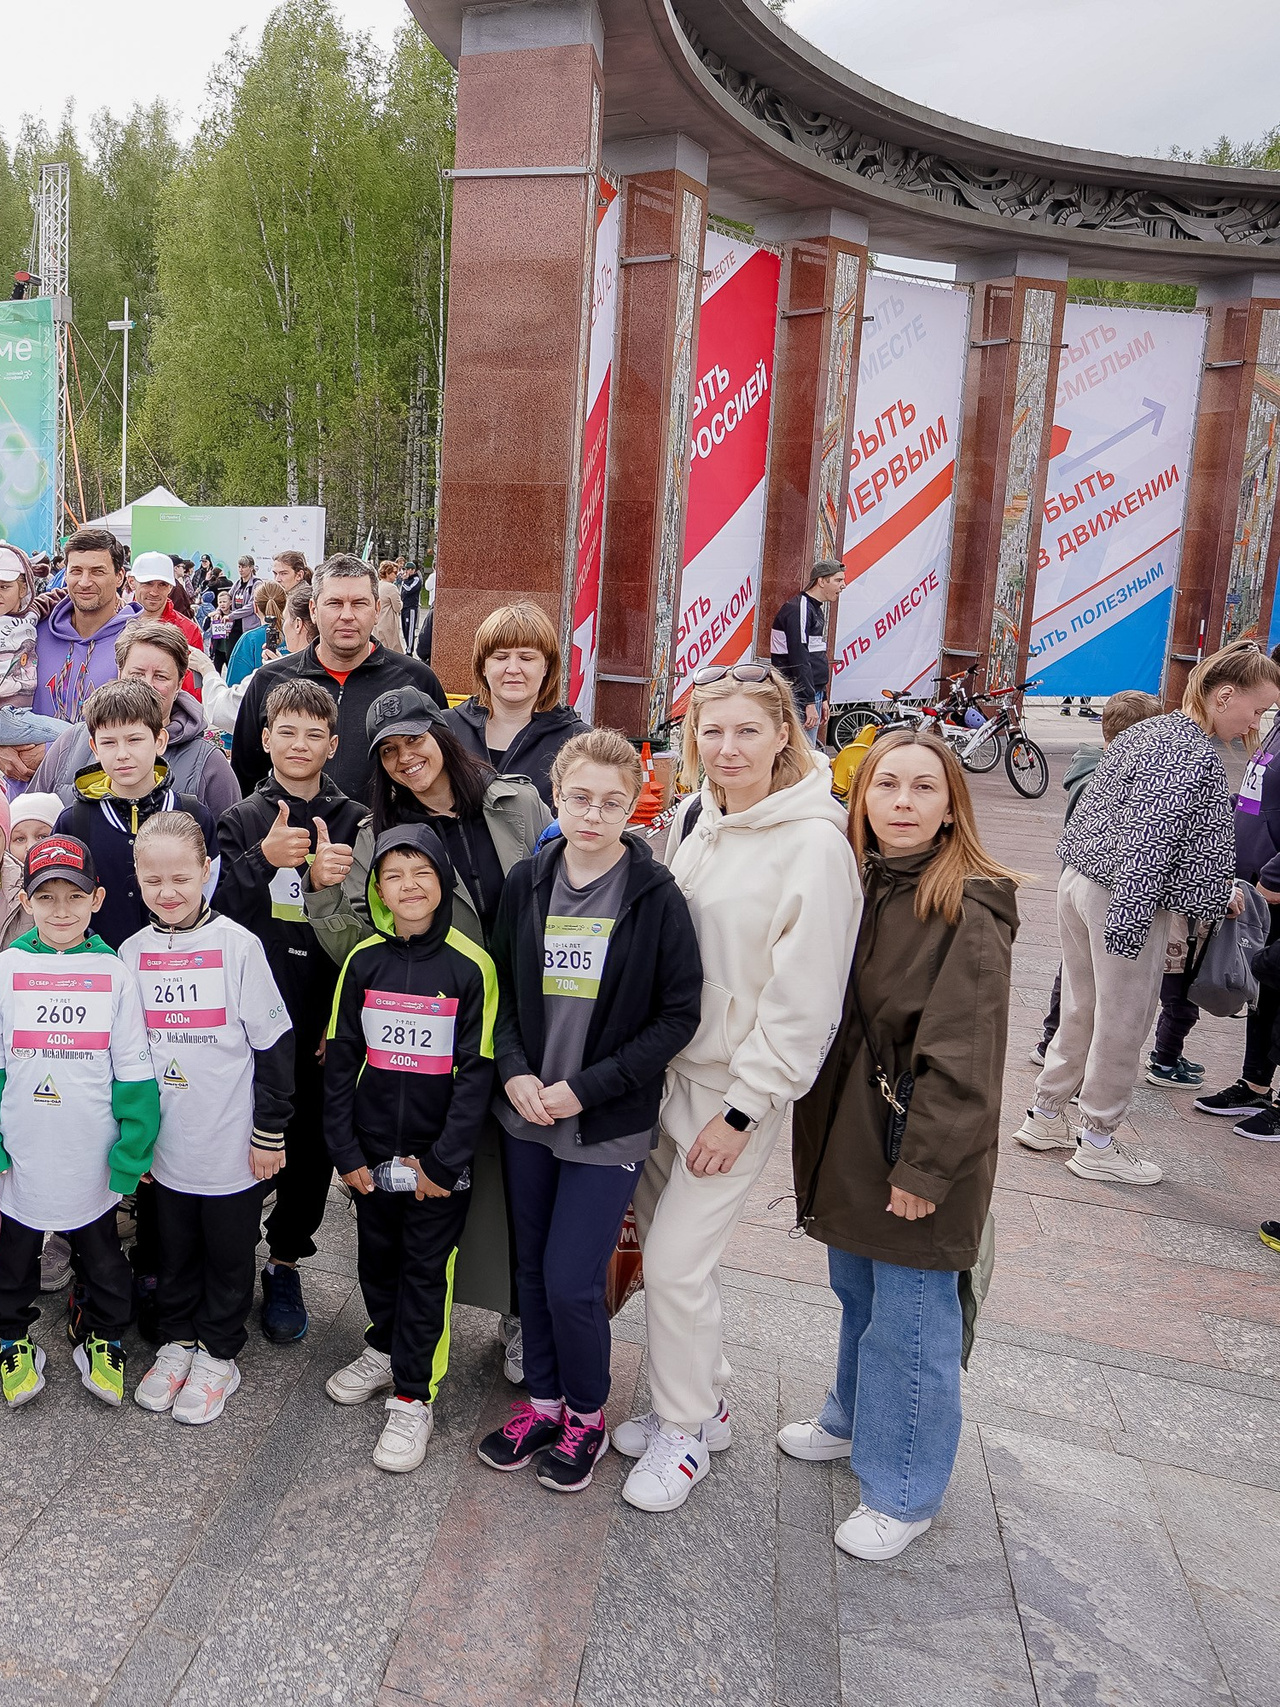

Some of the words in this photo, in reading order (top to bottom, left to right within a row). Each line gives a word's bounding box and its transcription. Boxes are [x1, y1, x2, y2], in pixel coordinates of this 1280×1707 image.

[863, 294, 905, 341] ЫТЬ
[860, 314, 928, 386] МЕСТЕ
[693, 364, 730, 419] ЫТЬ
[1037, 548, 1051, 571] В
[1057, 464, 1180, 561] ДВИЖЕНИИ
[1043, 470, 1115, 524] БЫТЬ
[674, 575, 753, 689] ЛОВЕКОМ
[676, 595, 711, 646] ЫТЬ
[832, 636, 871, 676] ЫТЬ
[874, 568, 940, 640] ВМЕСТЕ
[1028, 628, 1068, 661] ЫТЬ
[1070, 562, 1165, 633] ПОЛЕЗНЫМ
[544, 949, 592, 970] 3205
[154, 984, 197, 1003] 2611
[556, 979, 579, 991] 700м
[36, 1005, 87, 1024] 2609
[165, 1013, 190, 1024] 400м
[381, 1025, 432, 1048] 2812
[47, 1034, 74, 1045] 400м
[390, 1054, 418, 1067] 400м
